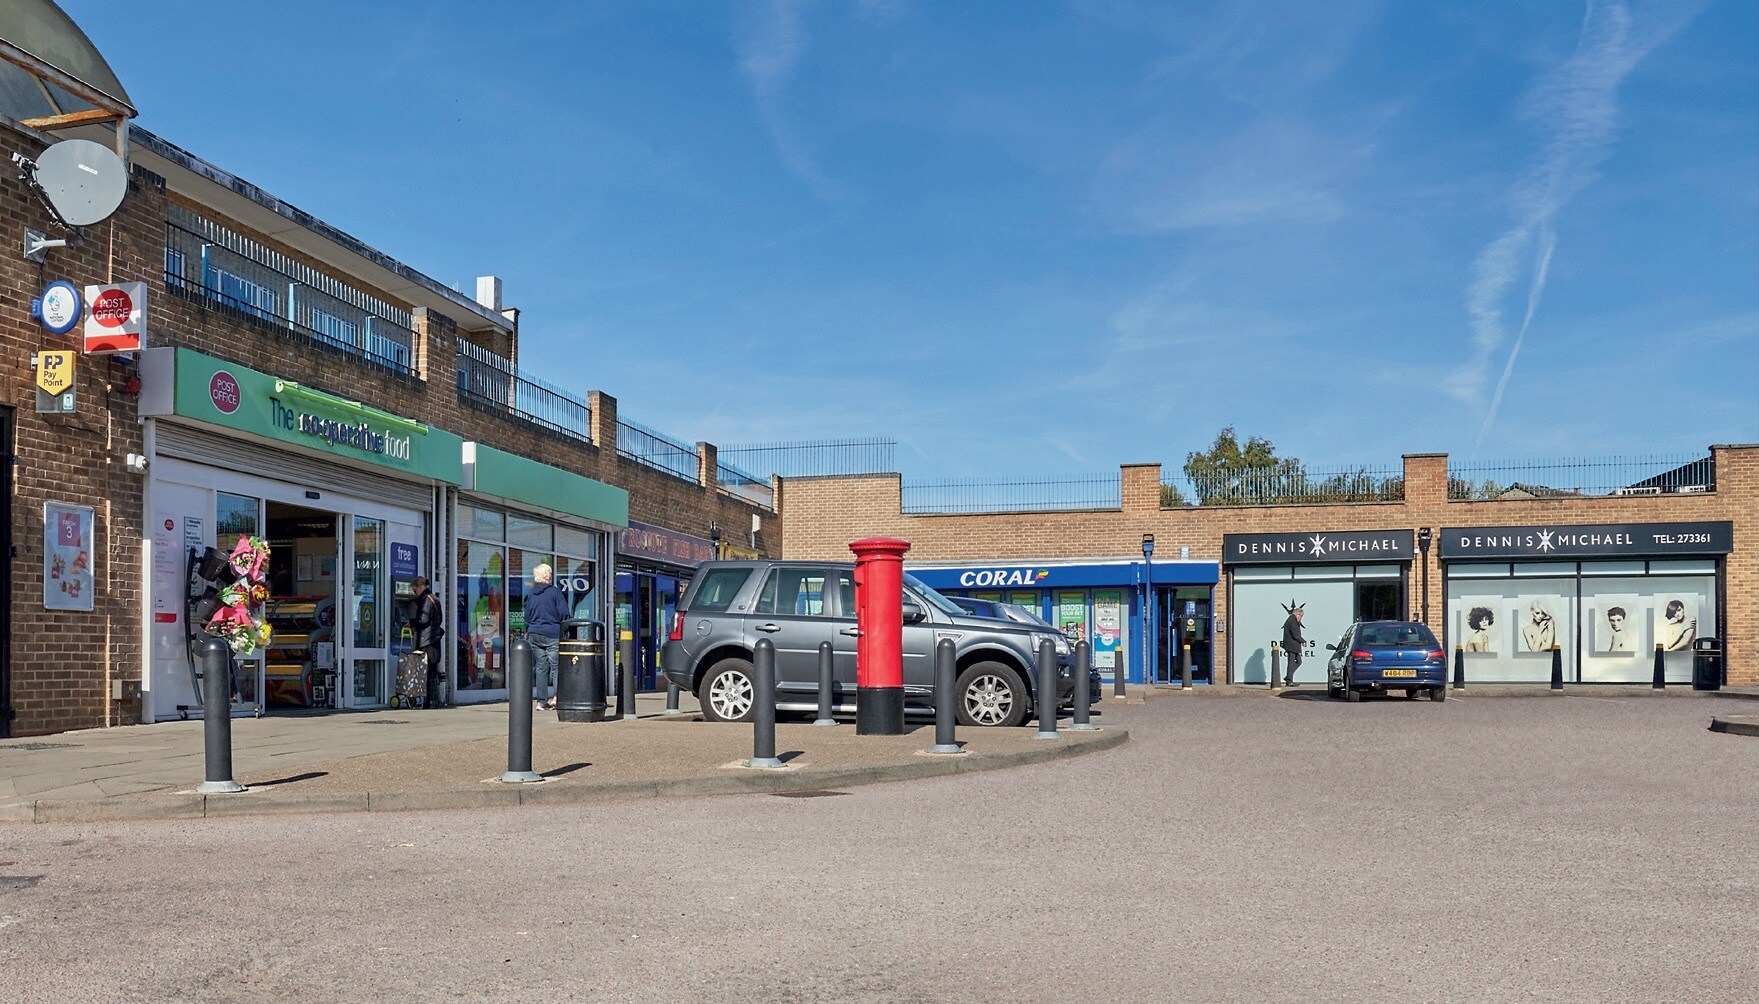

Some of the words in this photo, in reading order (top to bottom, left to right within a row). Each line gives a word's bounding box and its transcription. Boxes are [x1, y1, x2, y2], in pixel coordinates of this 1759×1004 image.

[99, 298, 125, 309] POST
[95, 308, 129, 320] OFFICE
[43, 370, 57, 380] Pay
[43, 378, 63, 387] Point
[216, 378, 235, 393] POST
[212, 390, 237, 405] OFFICE
[269, 396, 294, 431] The
[385, 429, 410, 461] food
[66, 526, 73, 539] 3
[1238, 541, 1306, 554] DENNIS
[1329, 539, 1399, 552] MICHAEL
[1461, 535, 1533, 548] DENNIS
[1558, 533, 1633, 547] MICHAEL
[1653, 534, 1675, 544] TEL:
[1677, 533, 1711, 544] 273361
[397, 546, 412, 561] free
[672, 538, 691, 560] FISH
[959, 569, 1037, 588] CORAL
[1271, 640, 1316, 648] DES
